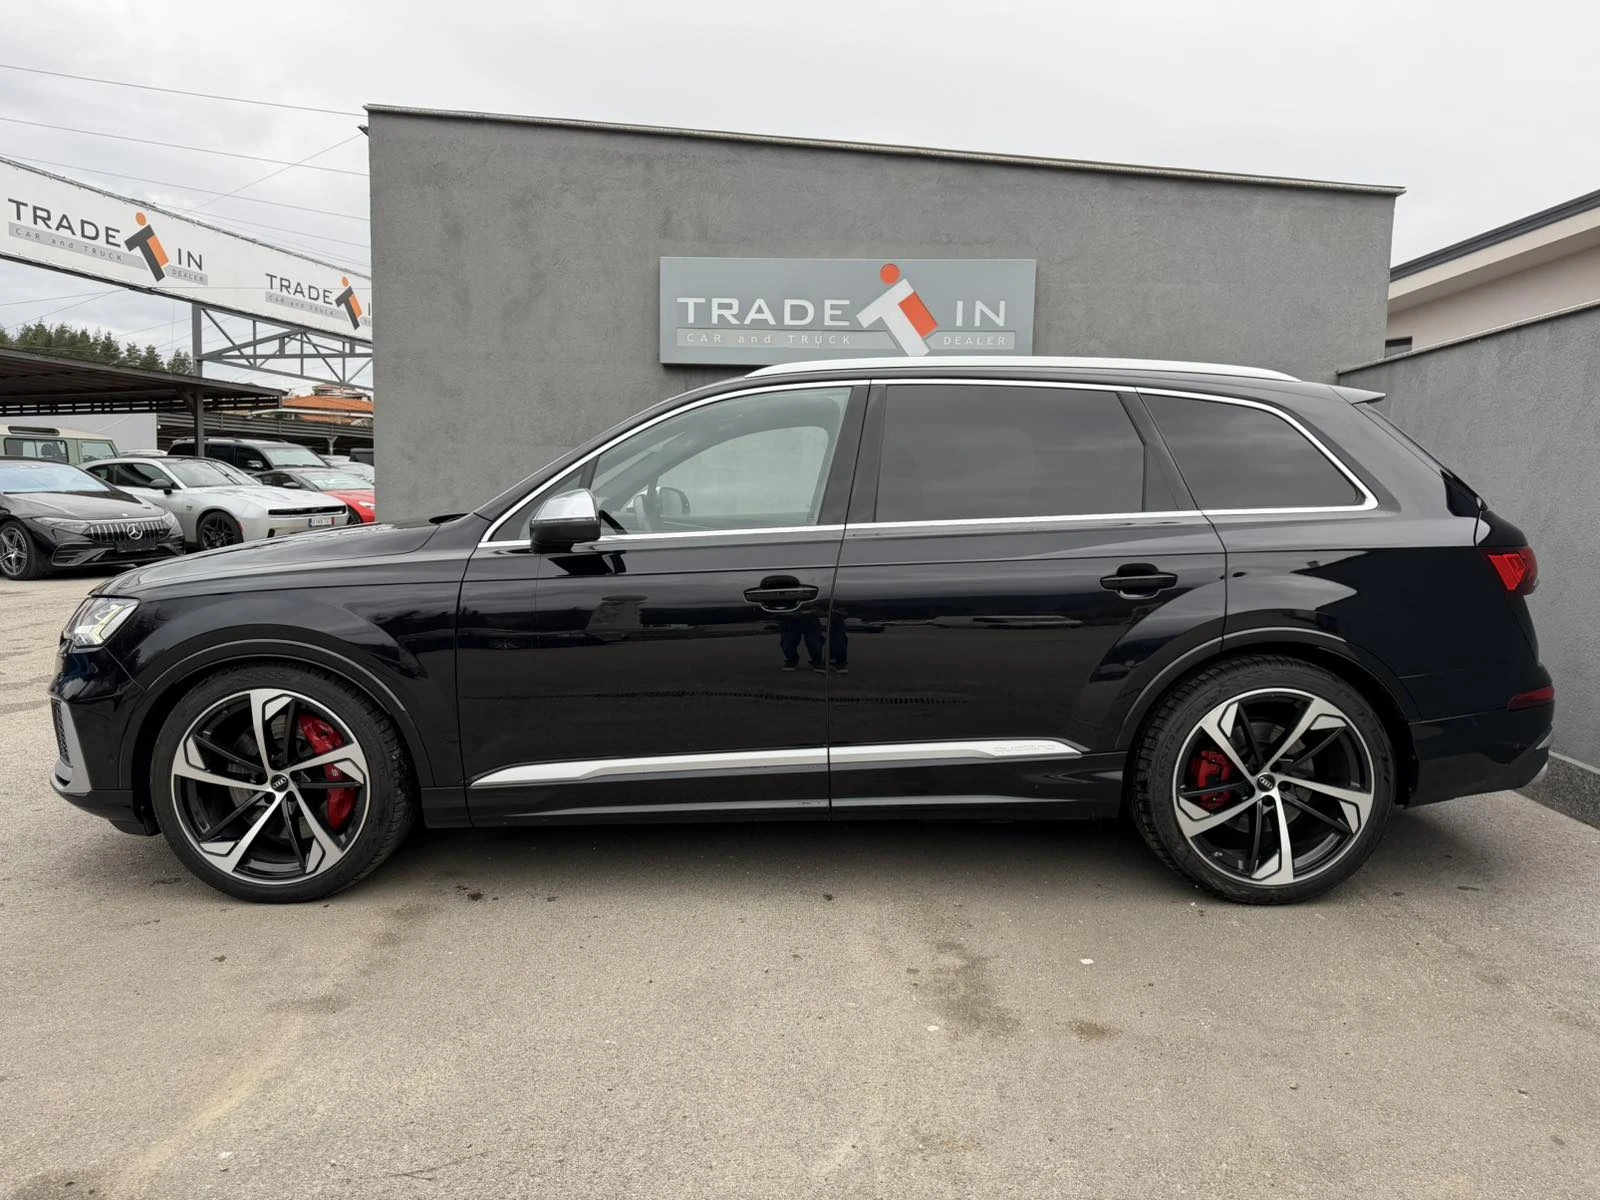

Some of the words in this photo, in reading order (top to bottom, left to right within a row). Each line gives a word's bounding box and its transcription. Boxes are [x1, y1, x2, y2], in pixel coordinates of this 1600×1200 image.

[8, 198, 121, 248] TRADE
[178, 248, 203, 271] IN
[15, 228, 40, 240] CAR
[51, 239, 74, 249] and
[82, 246, 122, 261] TRUCK
[171, 268, 205, 281] DEALER
[265, 273, 333, 305] TRADE
[677, 297, 850, 326] TRADE
[955, 300, 1006, 327] IN
[686, 332, 721, 342] CAR
[738, 335, 771, 344] and
[788, 335, 850, 345] TRUCK
[943, 336, 1006, 345] DEALER
